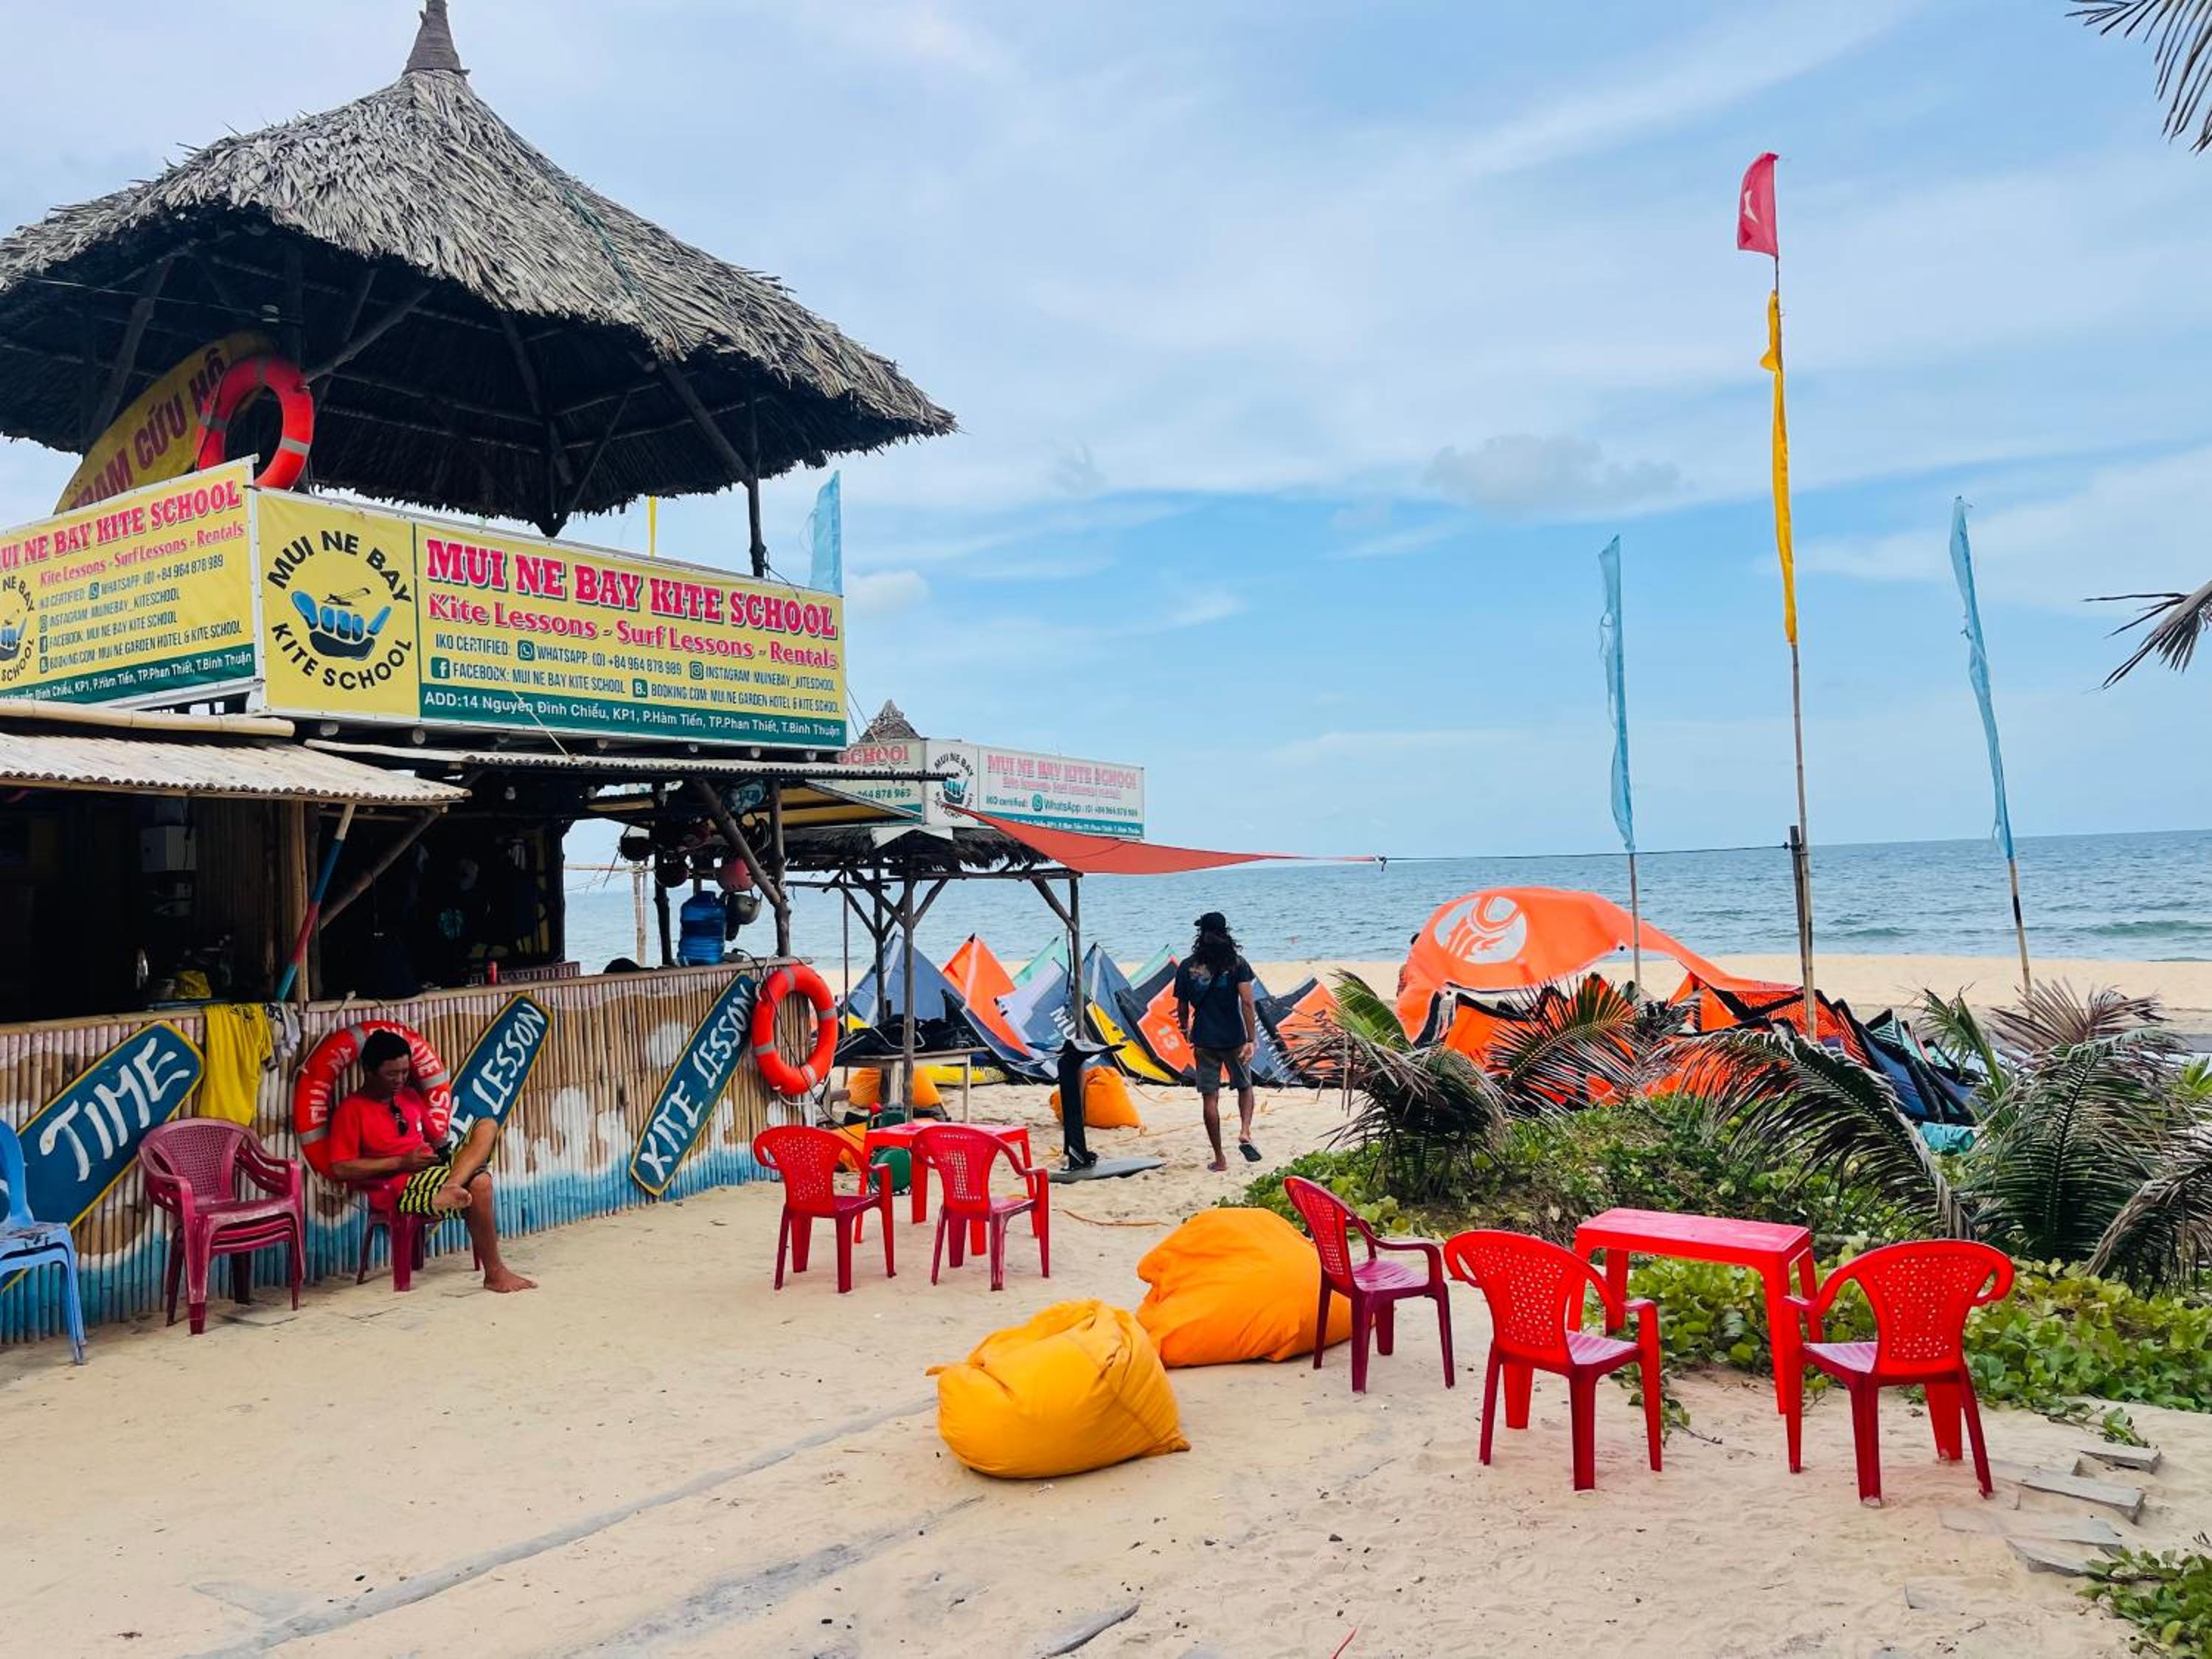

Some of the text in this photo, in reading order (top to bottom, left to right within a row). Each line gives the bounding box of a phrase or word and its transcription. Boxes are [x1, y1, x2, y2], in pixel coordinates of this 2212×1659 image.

[0, 480, 242, 572] UI NE BAY KITE SCHOOL
[41, 569, 62, 586] Kite
[63, 560, 106, 580] Lessons
[114, 546, 139, 567] Surf
[140, 538, 187, 561] Lessons
[197, 521, 245, 548] Rentals
[3, 576, 35, 612] NE BAY
[267, 530, 411, 603] MUI NE BAY
[427, 539, 838, 639] MUI NE BAY KITE SCHOOL
[147, 611, 177, 628] SCHOOL
[157, 632, 182, 649] HOTEL
[191, 626, 209, 641] KITE
[210, 620, 242, 638] SCHOOL
[429, 594, 489, 626] Kite
[494, 602, 598, 640] Lessons
[616, 619, 666, 647] Surf
[669, 627, 754, 659] Lessons
[770, 640, 838, 669] Rentals
[436, 633, 453, 650] IKO
[593, 653, 605, 667] (0)
[609, 655, 626, 669] +84
[627, 656, 645, 671] 964
[647, 658, 664, 673] 878
[271, 622, 412, 690] KITE SCHOOL
[512, 669, 530, 684] MUI
[533, 671, 546, 686] NE
[548, 672, 566, 687] BAY
[569, 674, 589, 690] KITE
[592, 677, 625, 694] SCHOOL
[769, 695, 791, 709] HOTEL
[425, 691, 479, 709] ADD:14
[613, 708, 640, 723] KP1,
[709, 716, 750, 730] TP.Phan
[472, 1004, 545, 1116] LESSON
[641, 984, 755, 1181] KITE LESSON
[39, 1037, 190, 1181] TIME
